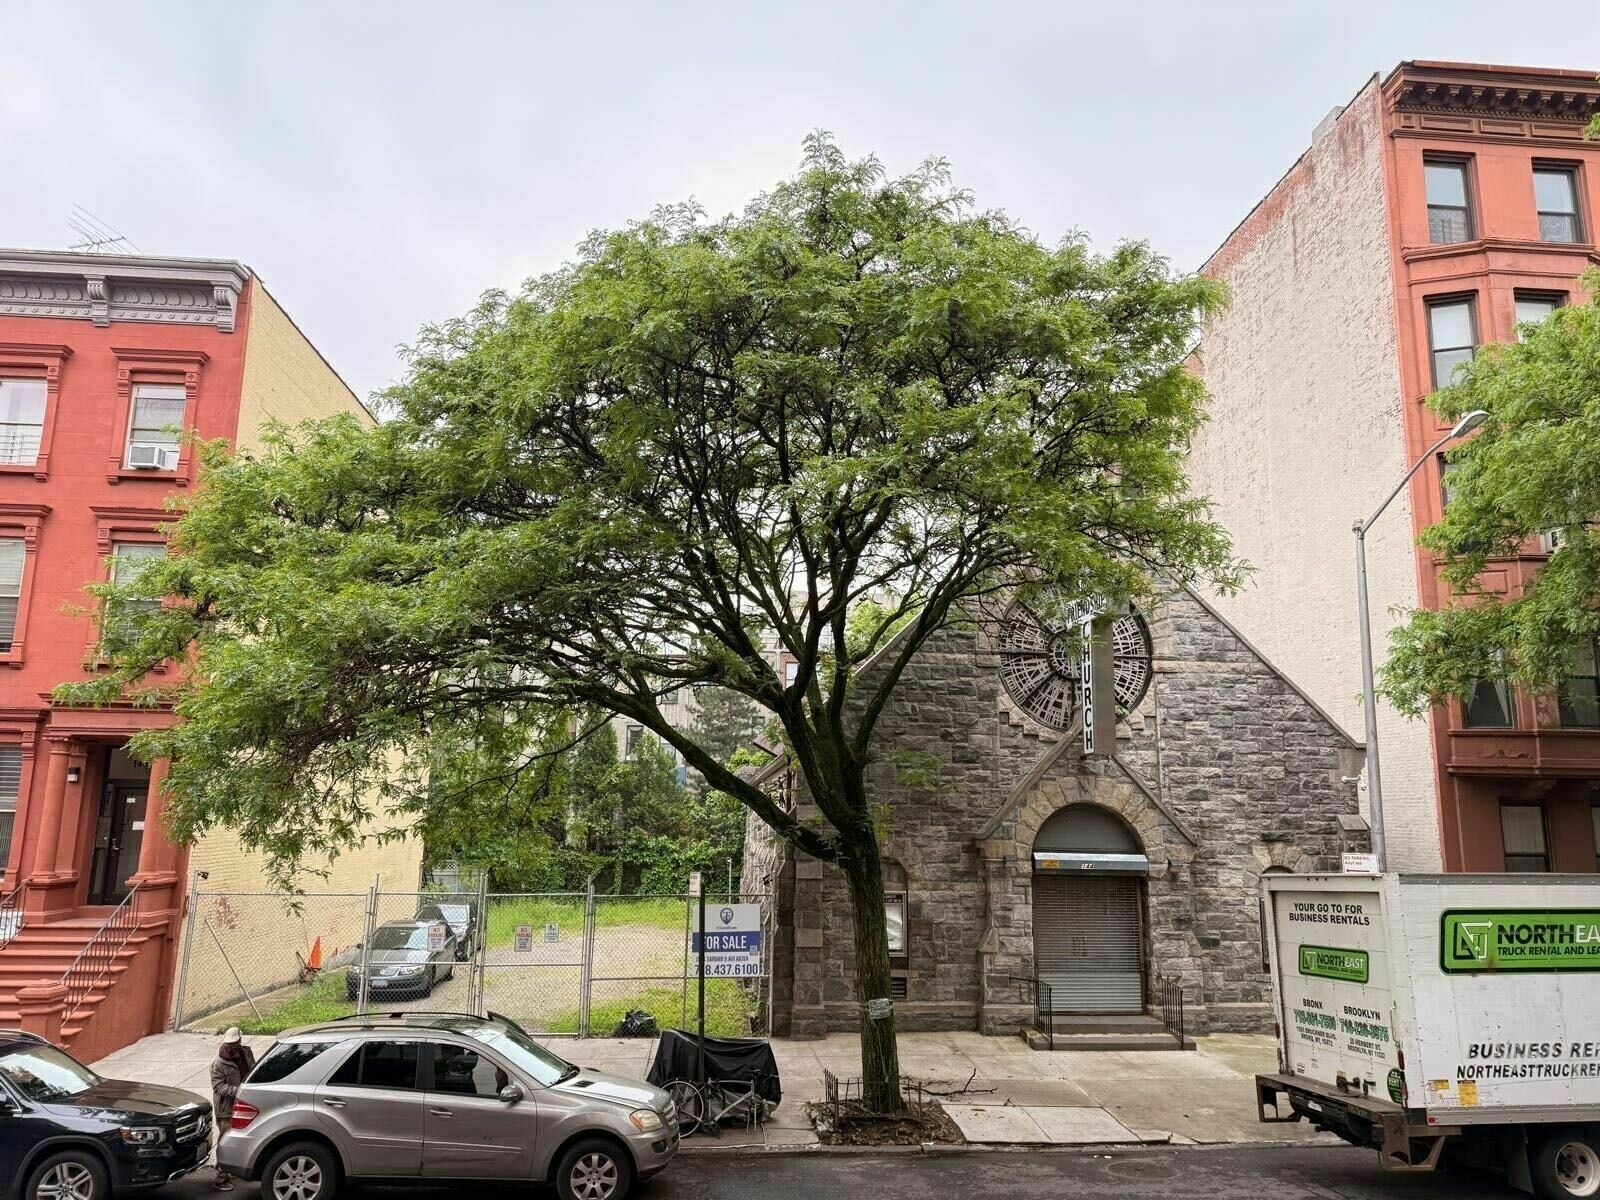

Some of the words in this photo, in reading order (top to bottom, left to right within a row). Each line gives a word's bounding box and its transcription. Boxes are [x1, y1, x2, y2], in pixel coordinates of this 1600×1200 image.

[1082, 621, 1093, 750] CHURCH
[1293, 902, 1315, 912] YOUR
[1317, 903, 1329, 913] GO
[1331, 904, 1342, 913] TO
[1345, 904, 1363, 914] FOR
[1289, 912, 1328, 923] BUSINESS
[1330, 914, 1370, 926] RENTALS
[722, 935, 748, 949] SALE
[1498, 946, 1526, 955] TRUCK
[1529, 946, 1562, 955] RENTAL
[1564, 946, 1585, 955] AND
[1317, 953, 1365, 969] NORTHEAST
[694, 964, 758, 975] 78.437.6100
[1302, 998, 1323, 1009] BRONX
[1343, 1005, 1381, 1021] BROOKLYN
[1467, 1042, 1563, 1060] BUSINESS
